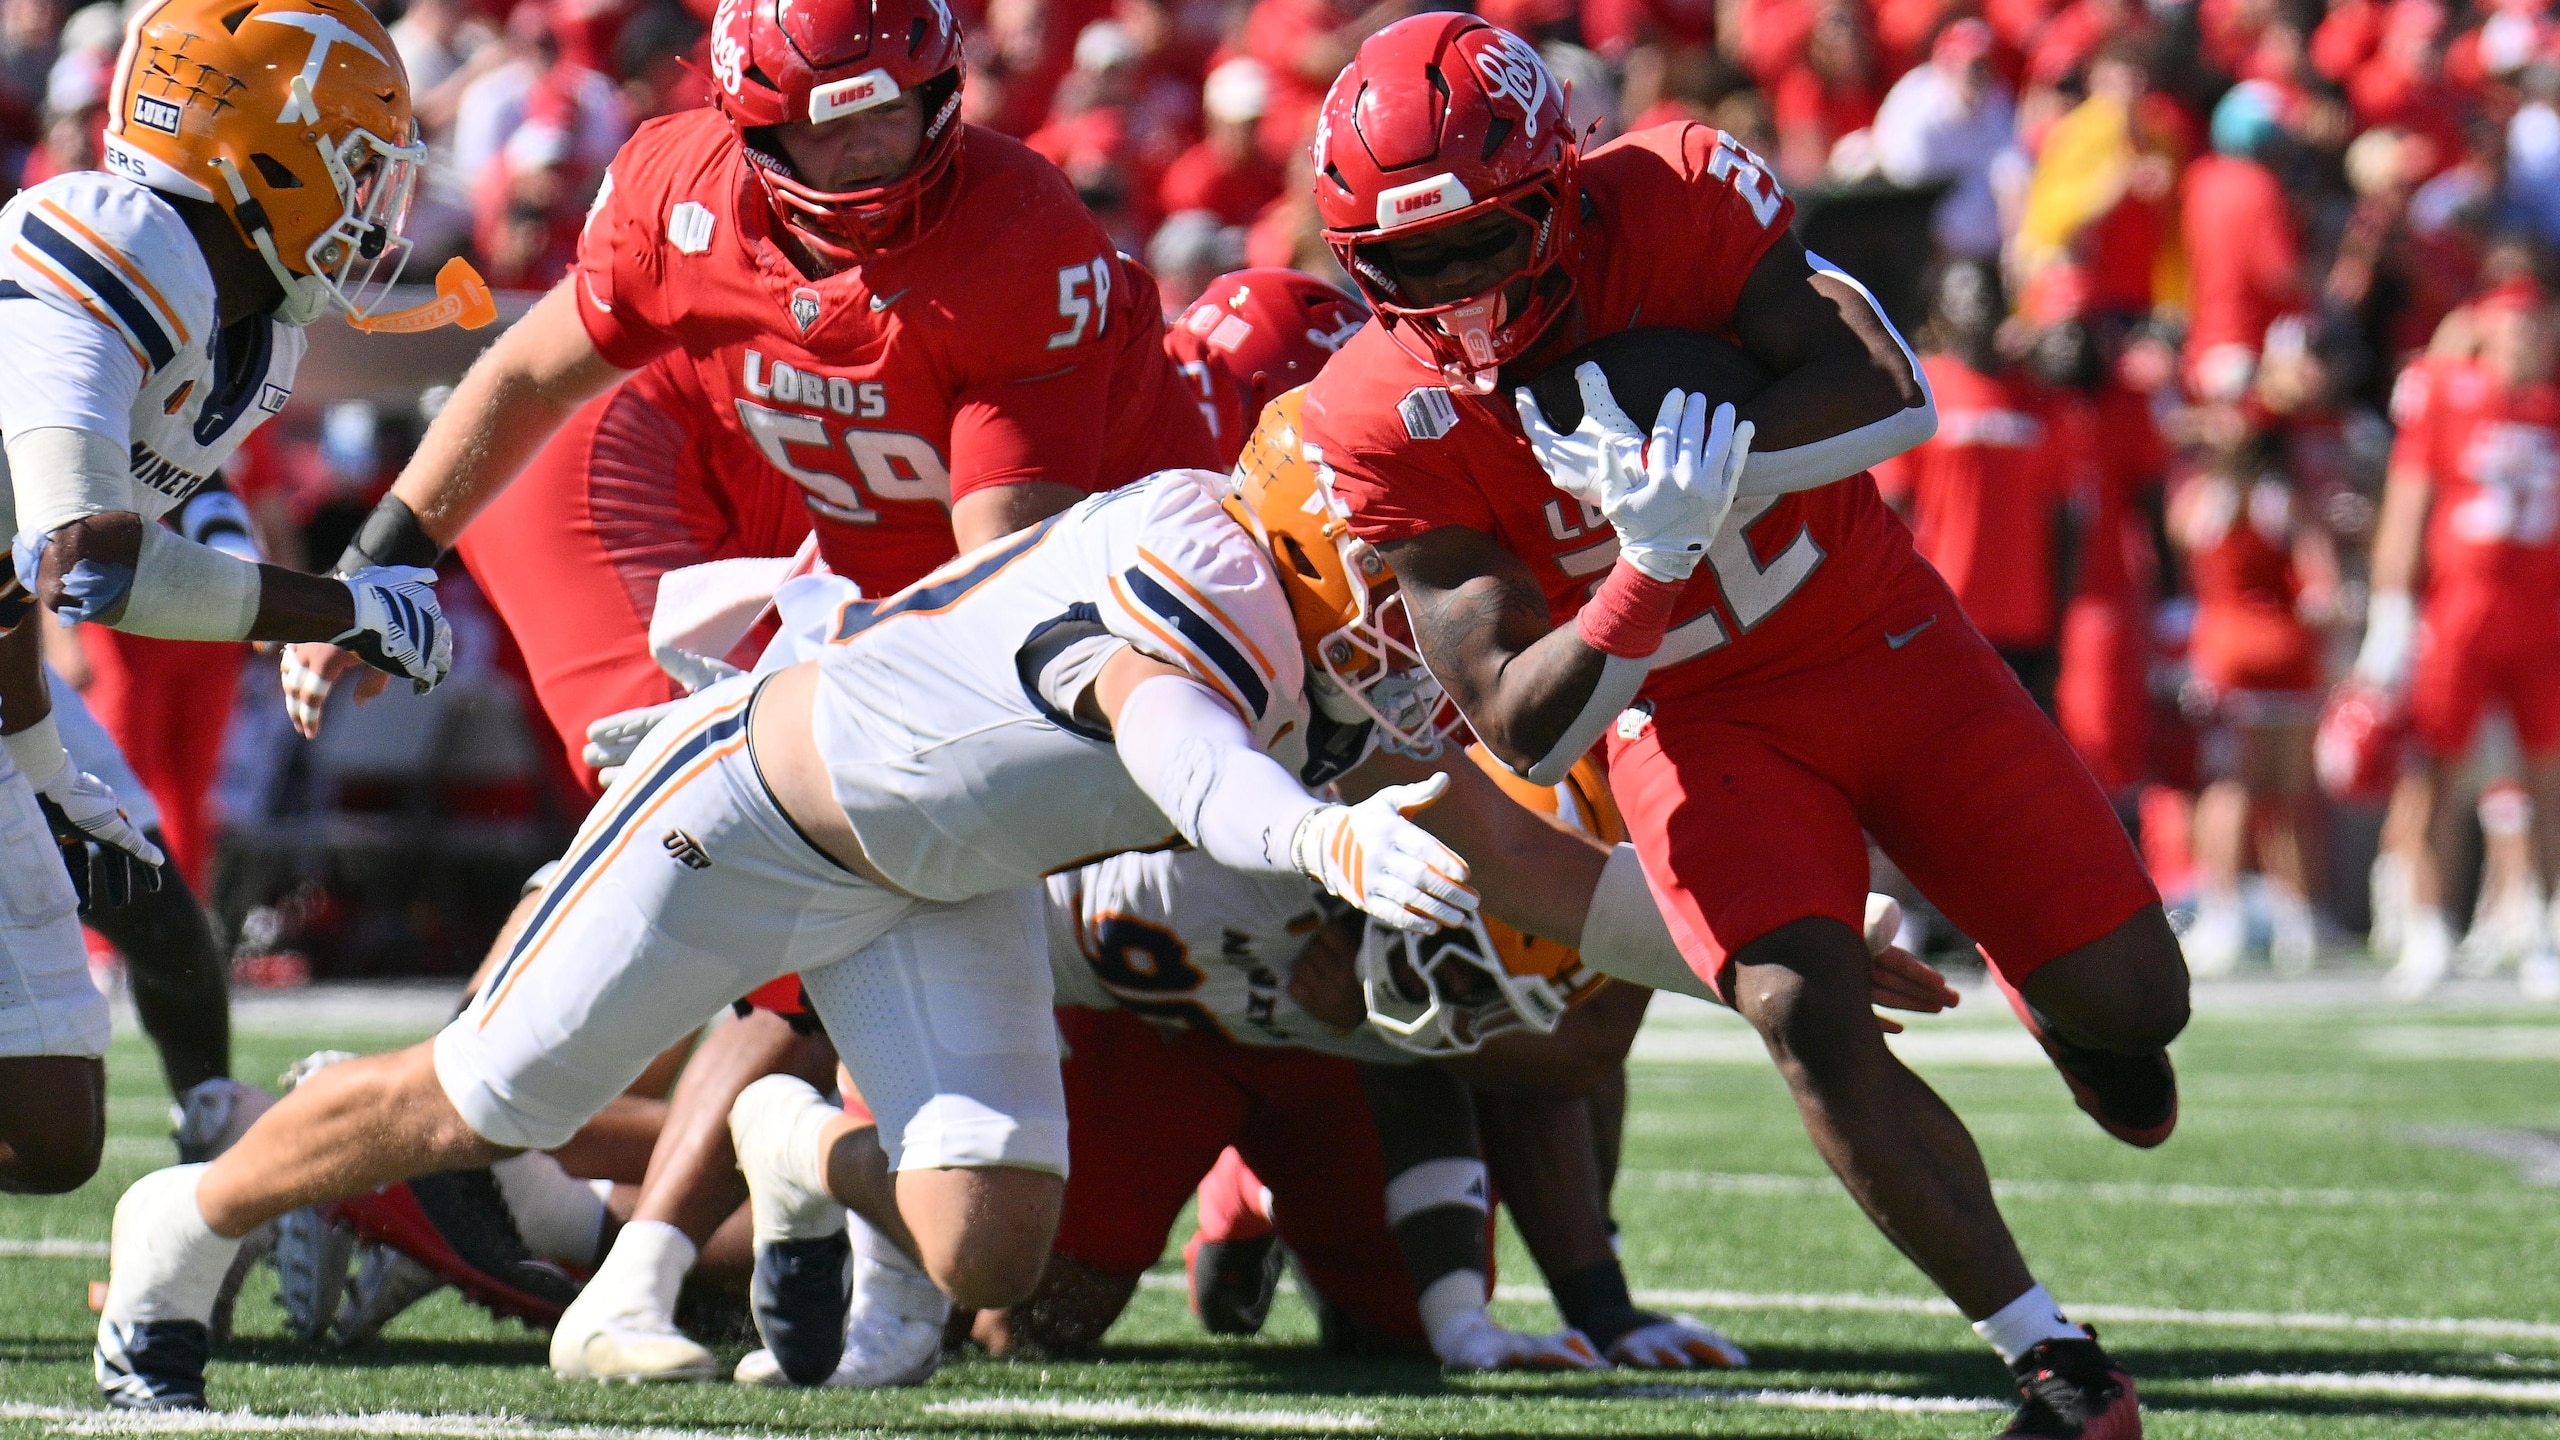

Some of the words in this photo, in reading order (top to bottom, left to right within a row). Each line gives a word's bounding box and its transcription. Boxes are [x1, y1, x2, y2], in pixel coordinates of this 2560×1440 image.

[134, 97, 179, 131] LUKE
[829, 81, 876, 108] LOBOS
[926, 91, 963, 140] Riddell
[104, 145, 147, 177] ERS
[1393, 188, 1442, 214] LOBOS
[1045, 254, 1112, 350] 59
[743, 348, 889, 420] LOBOS
[734, 397, 953, 526] 59
